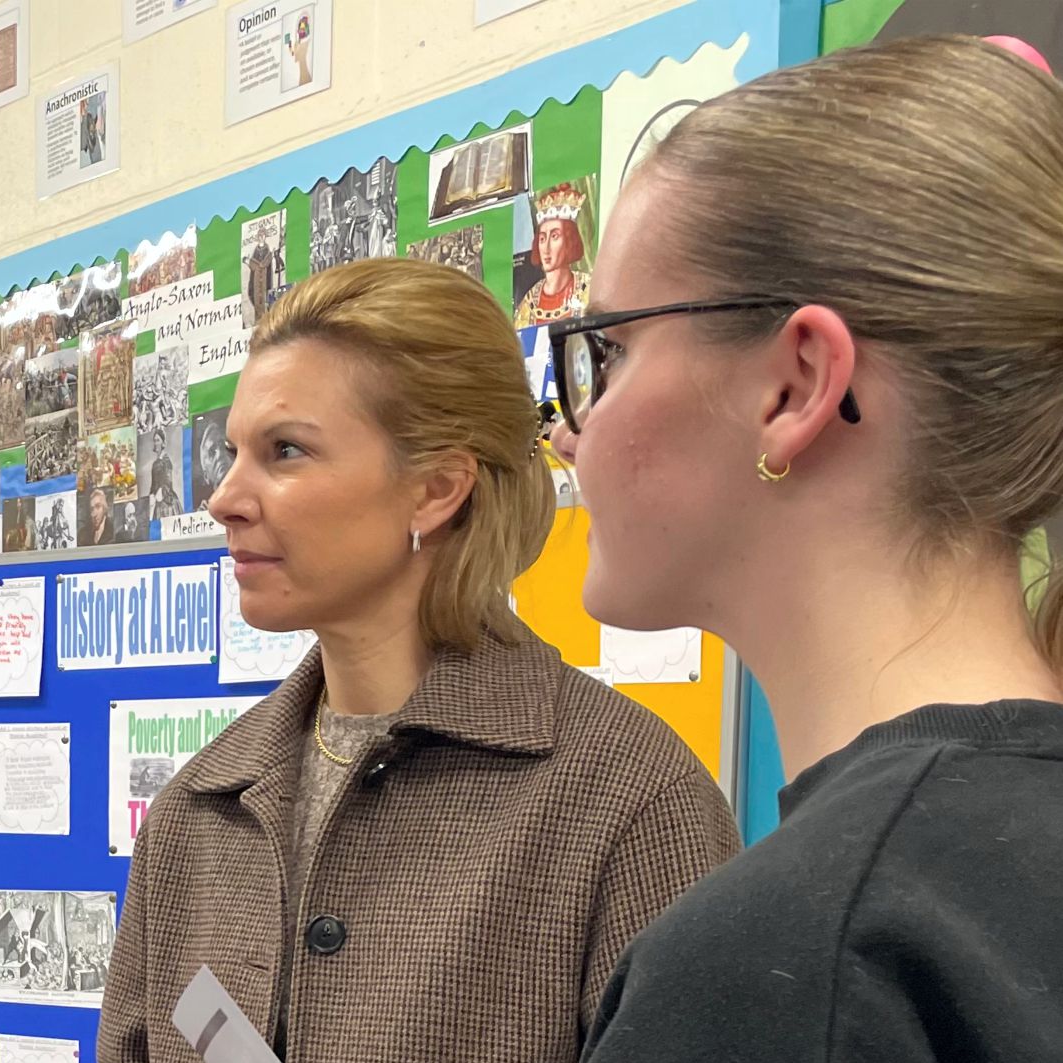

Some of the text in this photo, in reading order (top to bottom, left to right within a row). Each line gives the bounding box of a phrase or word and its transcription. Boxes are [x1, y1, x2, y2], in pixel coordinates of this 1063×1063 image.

[239, 6, 277, 33] Opinion
[46, 81, 98, 115] Anachronistic
[124, 281, 213, 328] Anglo-Saxon
[158, 302, 243, 341] and Norman
[199, 336, 248, 374] Engla
[61, 576, 125, 665] History
[129, 577, 147, 657] at
[150, 570, 163, 654] A
[166, 566, 214, 654] Level
[128, 710, 176, 758] Poverty
[178, 709, 202, 753] and
